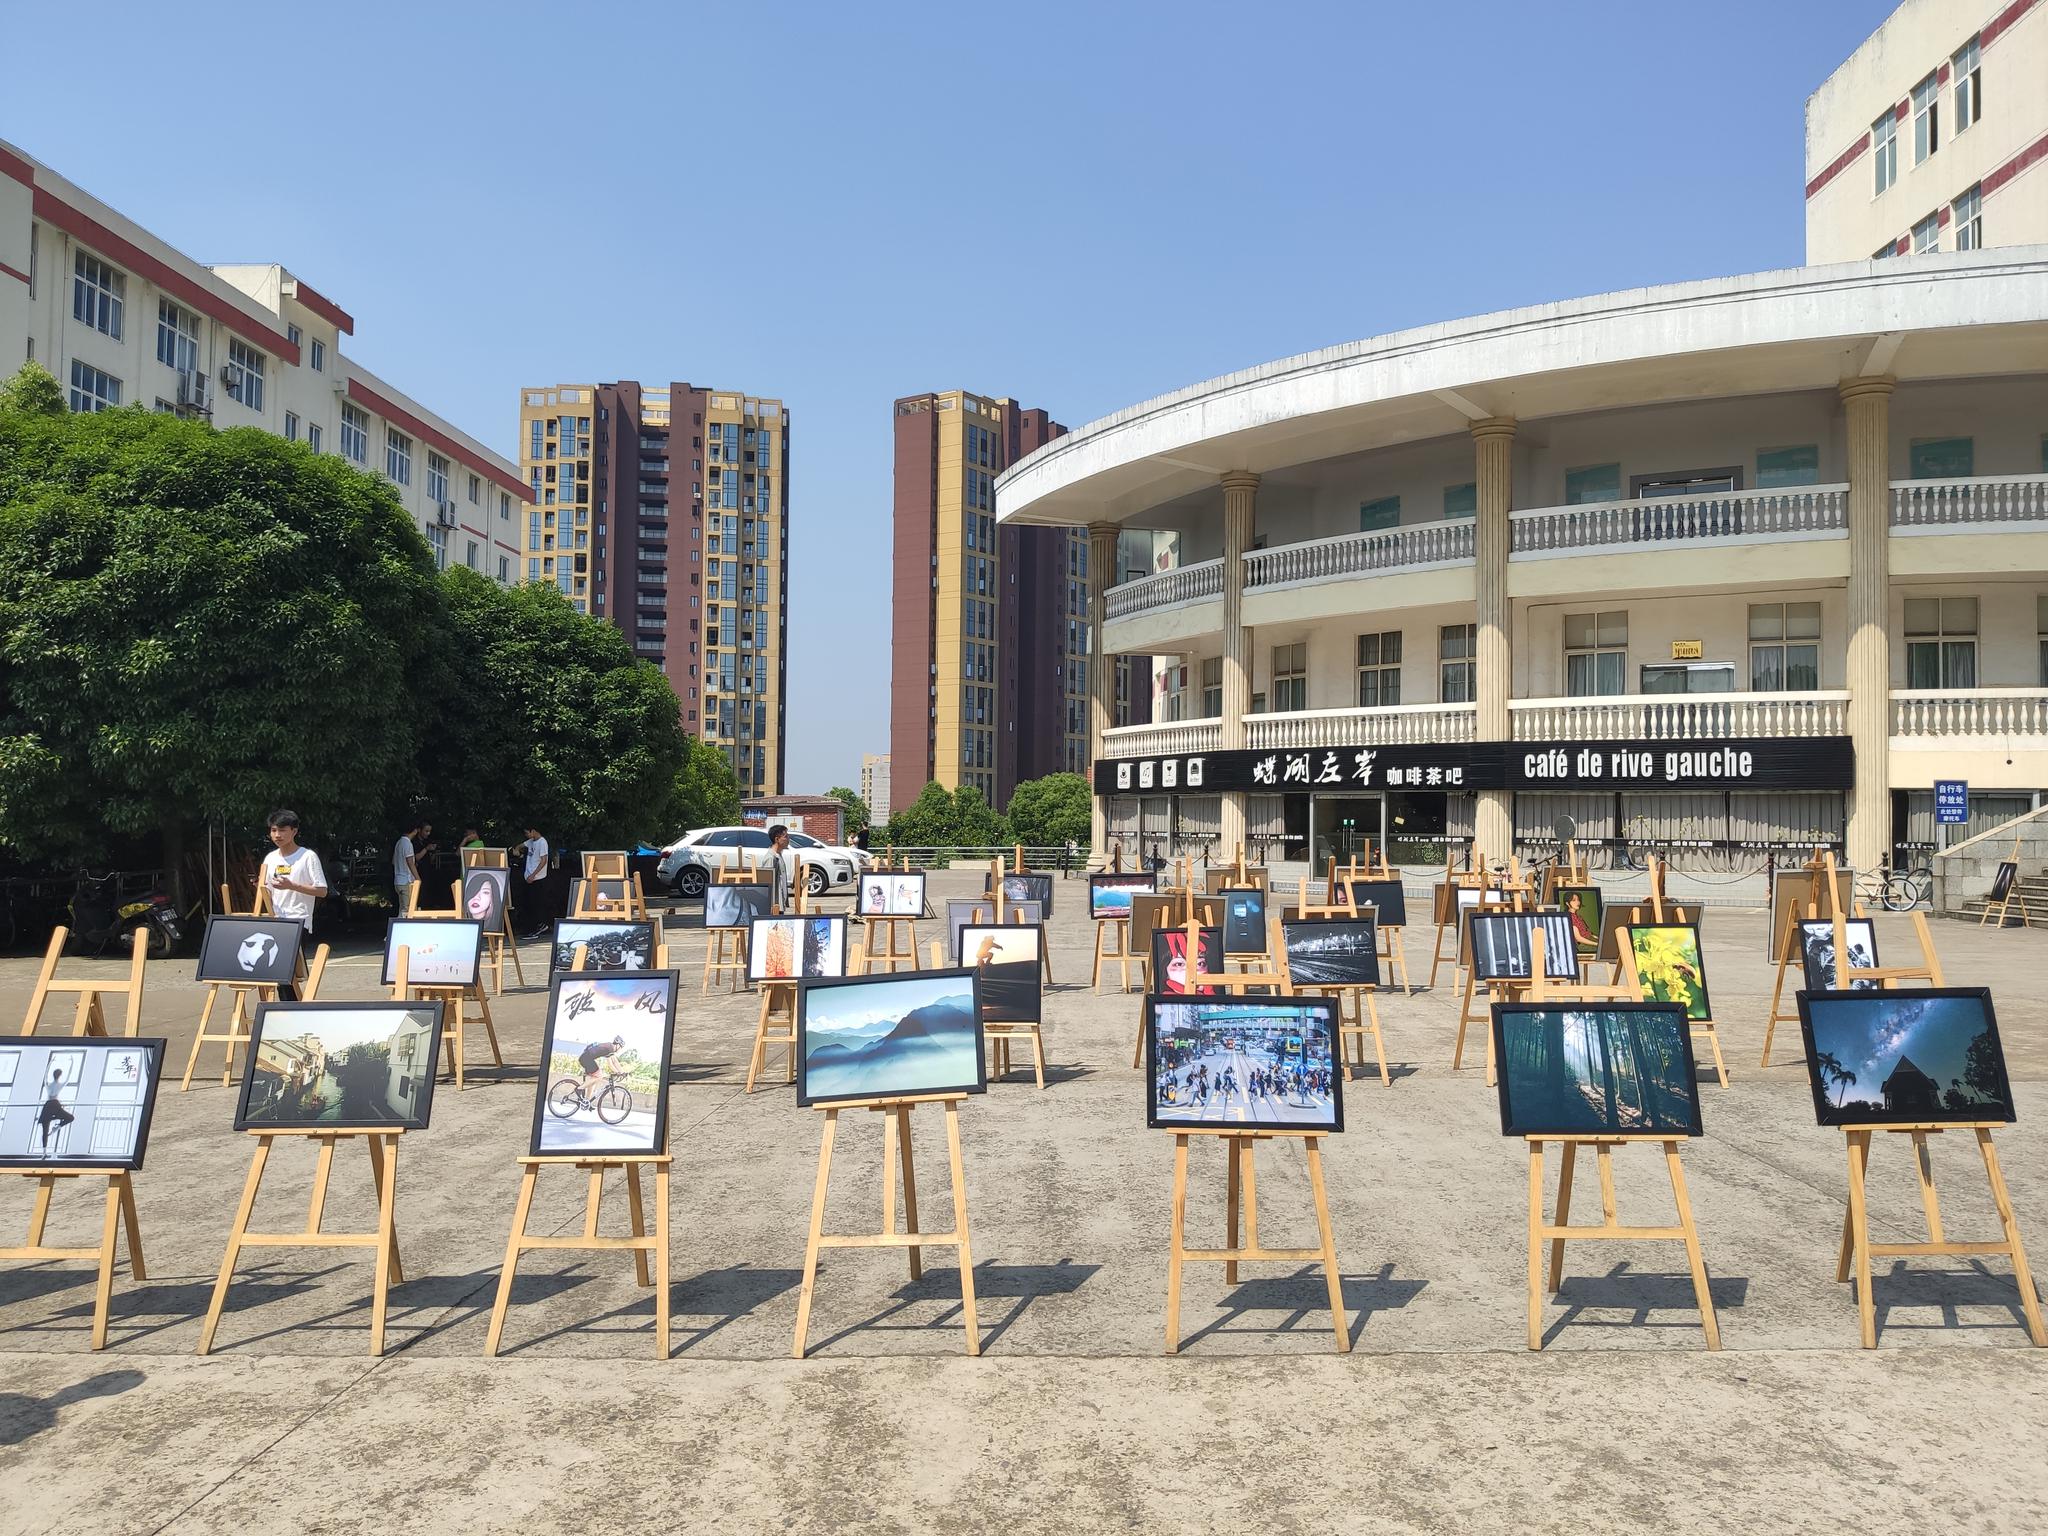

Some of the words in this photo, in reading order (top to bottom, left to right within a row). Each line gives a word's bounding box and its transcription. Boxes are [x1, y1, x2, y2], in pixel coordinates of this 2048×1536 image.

[1524, 750, 1568, 778] café
[1577, 748, 1602, 778] de
[1611, 749, 1653, 778] rive
[1665, 747, 1752, 781] gauche
[1386, 766, 1463, 786] 咖啡茶吧
[1939, 785, 1964, 794] 自行车
[1938, 795, 1964, 804] 停放处
